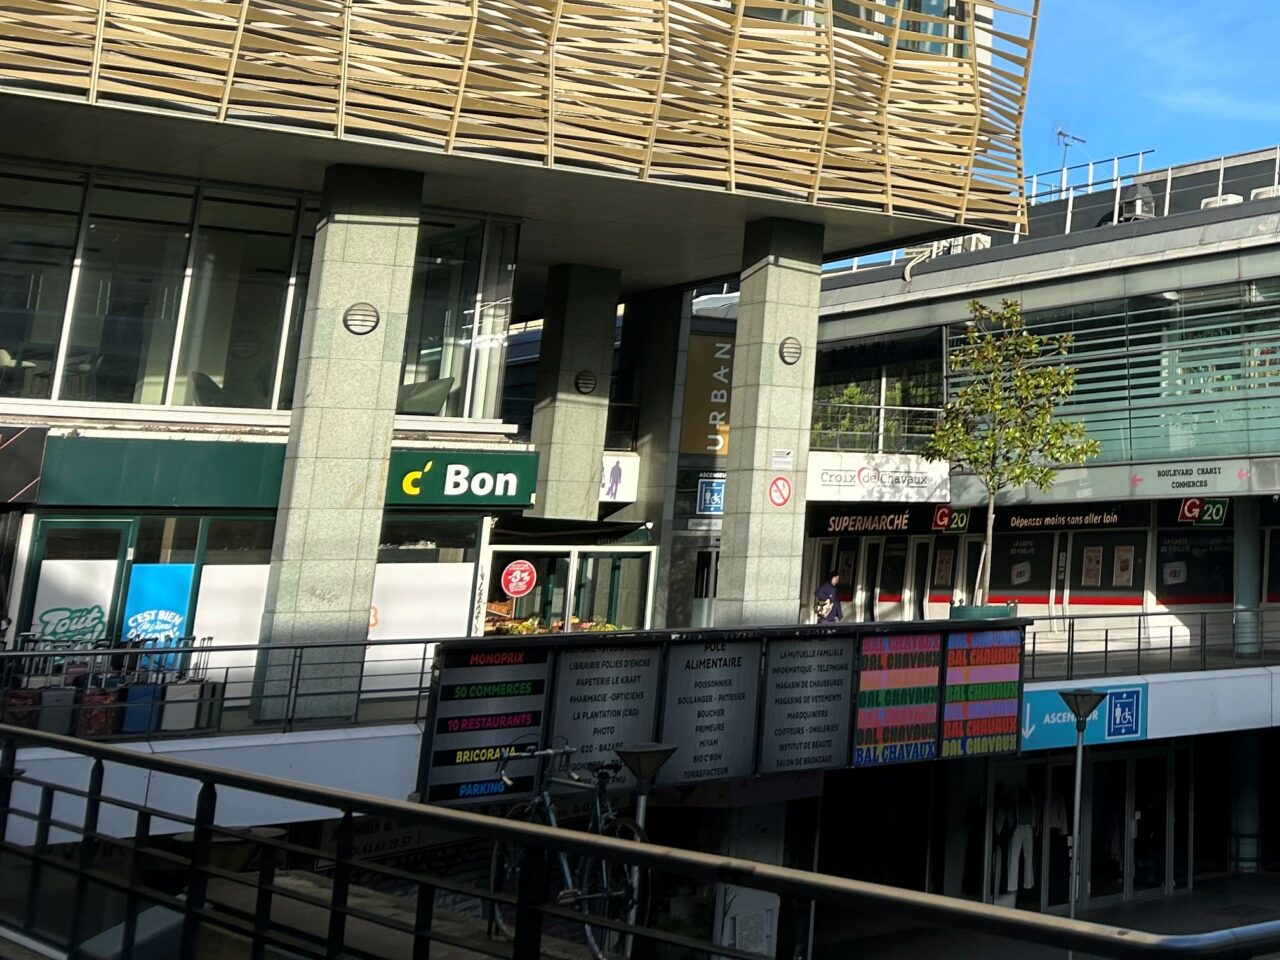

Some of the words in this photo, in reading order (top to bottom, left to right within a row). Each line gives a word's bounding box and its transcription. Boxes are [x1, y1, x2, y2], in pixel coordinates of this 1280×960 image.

[706, 342, 732, 450] URBAN
[820, 470, 856, 483] Croix
[862, 473, 877, 484] de
[880, 472, 928, 486] Chavaux
[1157, 468, 1194, 478] BOULEVARD
[1196, 466, 1222, 476] CHANZY
[444, 463, 518, 496] Bon
[1171, 479, 1209, 490] COMMERCES
[1183, 498, 1223, 521] G20
[827, 509, 910, 532] SUPERMARCHÉ
[936, 507, 967, 530] G20
[1010, 515, 1043, 529] Dépenser
[1044, 514, 1065, 527] moins
[1066, 515, 1083, 525] sans
[1083, 512, 1102, 525] aller
[1103, 511, 1118, 524] loin
[42, 605, 104, 637] Tout
[128, 610, 156, 627] C'EST
[158, 610, 183, 625] BIEN
[470, 651, 525, 666] MONOPRIX
[779, 651, 787, 659] LA
[788, 649, 816, 659] MUTUELLE
[816, 648, 843, 657] FAMILIALE
[569, 660, 600, 671] LIBRAIRIE
[601, 659, 623, 670] FOLIES
[624, 658, 651, 668] D'ENCRE
[684, 656, 743, 670] ALIMENTAIRE
[772, 665, 812, 675] INFORMATIQUE
[817, 662, 849, 672] TELEPHONIE
[576, 677, 610, 687] PAPETERIE
[611, 676, 619, 685] LE
[620, 675, 641, 685] KRAFT
[694, 679, 732, 689] POISSONNIER
[775, 680, 800, 690] MAGASIN
[801, 680, 809, 688] DE
[809, 678, 843, 688] CHAUSSURES
[454, 685, 467, 699] 50
[469, 682, 532, 697] COMMERCES
[569, 693, 607, 704] PHARMACIE
[678, 694, 713, 705] BOULANGER
[774, 695, 802, 705] MAGASINS
[803, 695, 811, 704] DE
[811, 693, 842, 703] VETEMENTS
[573, 711, 581, 721] LA
[582, 709, 621, 720] PLANTATION
[697, 708, 725, 718] BOUCHER
[787, 709, 829, 720] MAROQUINIERS
[448, 720, 459, 732] 10
[461, 713, 533, 730] RESTAURANTS
[695, 722, 725, 733] PRIMEURS
[592, 726, 615, 736] PHOTO
[774, 726, 805, 736] COIFFEURS
[808, 723, 839, 734] ONGLERIES
[699, 739, 719, 747] MIYAM
[778, 742, 803, 752] INSTITUT
[803, 742, 811, 750] DE
[693, 754, 704, 763] BIO
[855, 745, 878, 766] BAL
[882, 741, 936, 761] CHAVAUX
[776, 758, 794, 768] SALON
[795, 757, 803, 767] DE
[684, 766, 729, 778] TORREFACTEUR
[459, 781, 505, 797] PARKING
